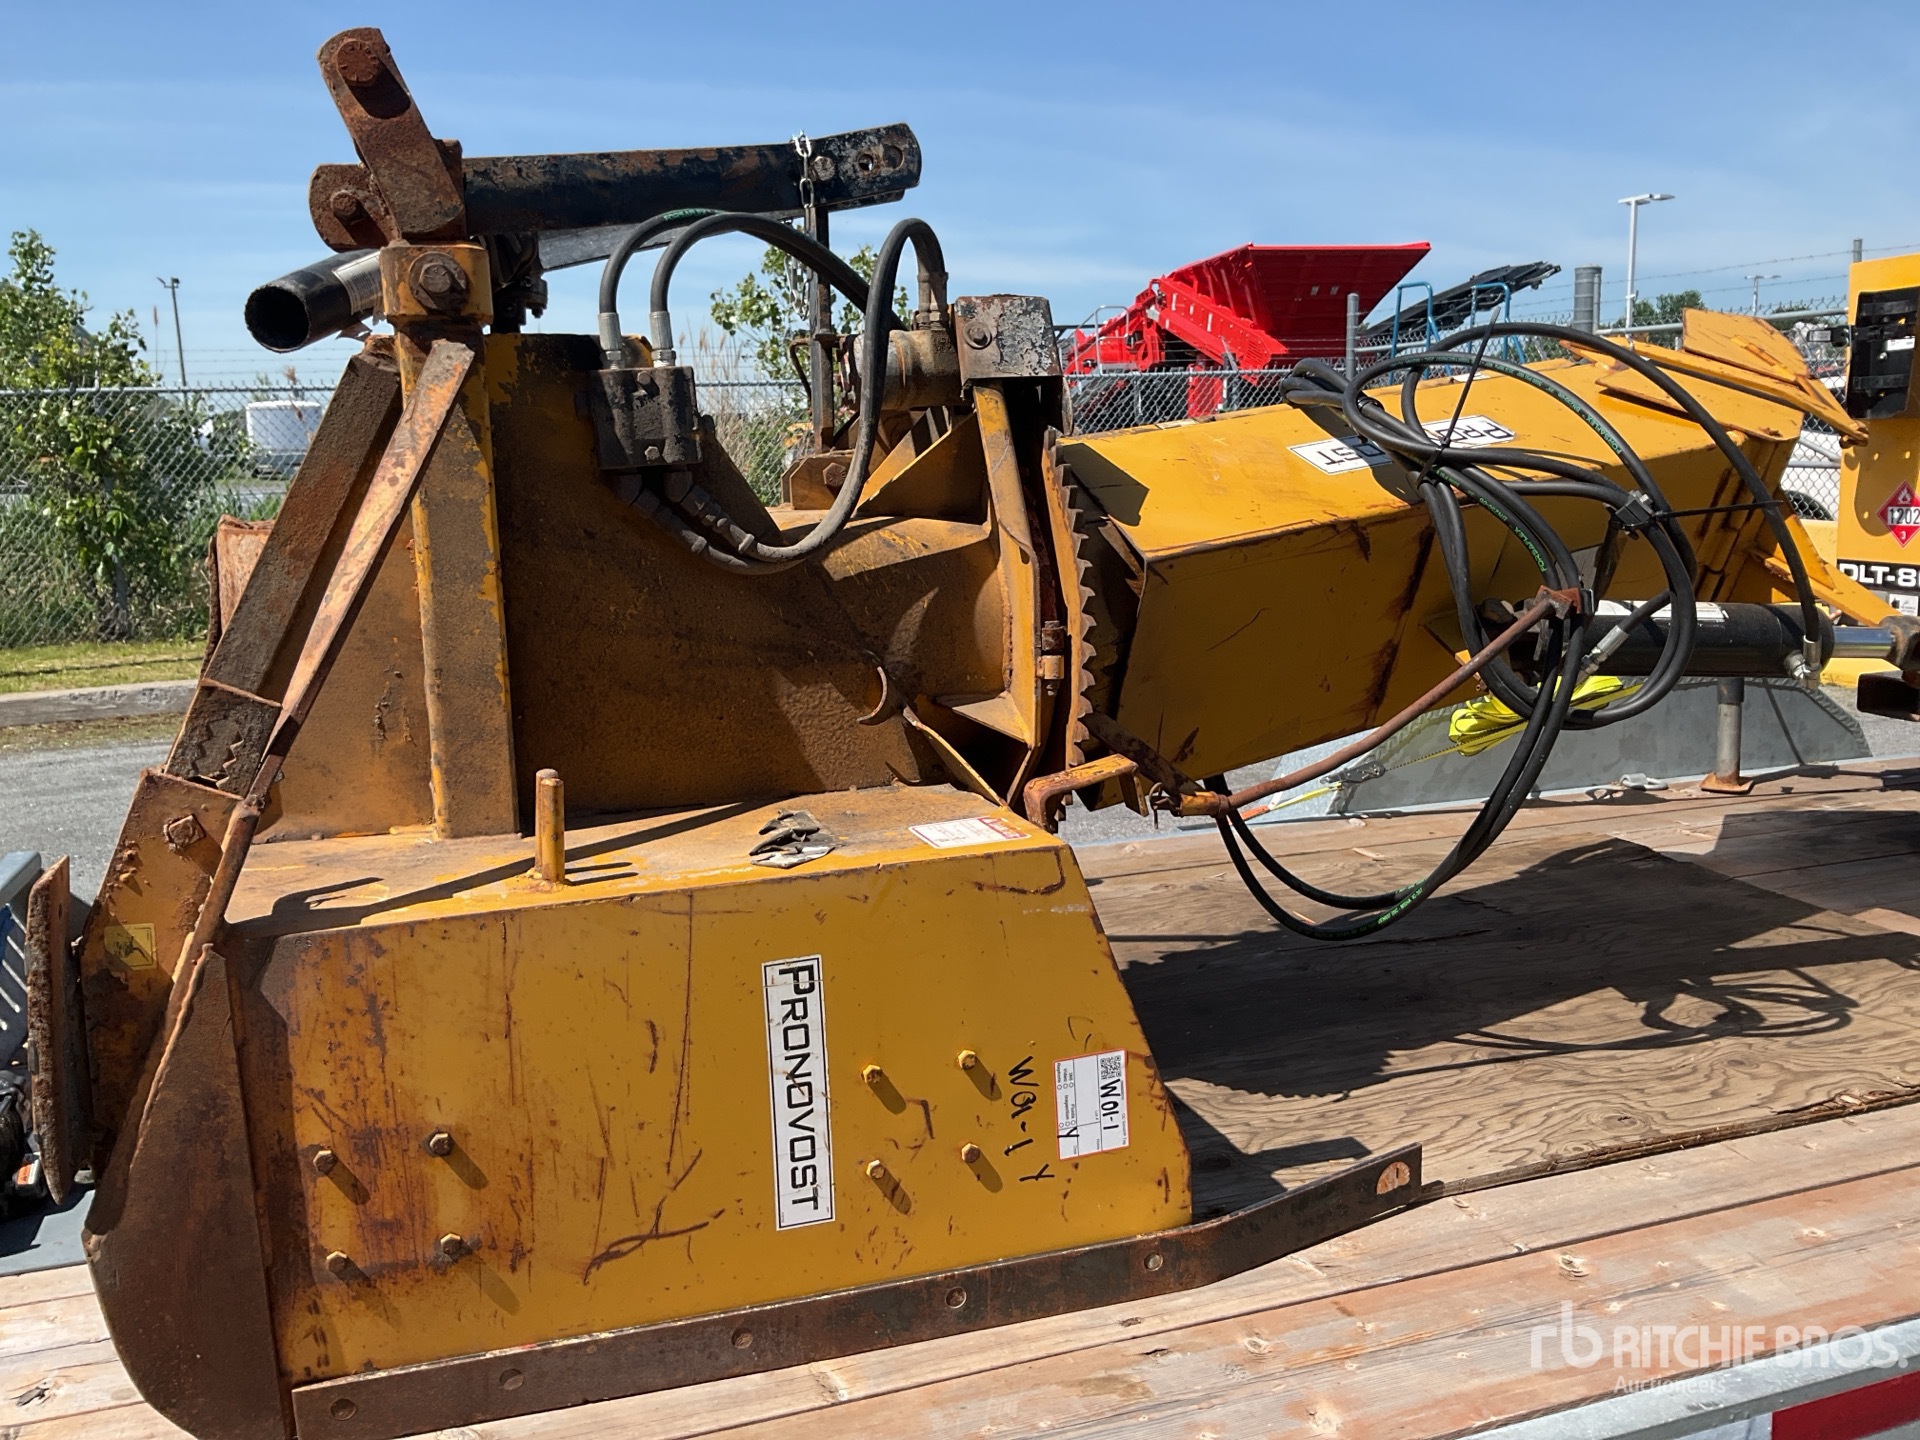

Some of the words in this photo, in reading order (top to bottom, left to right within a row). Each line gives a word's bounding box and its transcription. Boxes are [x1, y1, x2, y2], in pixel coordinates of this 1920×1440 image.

[1890, 508, 1920, 524] 1202
[1901, 530, 1906, 540] 3
[1514, 526, 1548, 572] FORSAFLEX
[1840, 563, 1920, 588] DLT-8
[778, 964, 818, 1210] PRONOVOST
